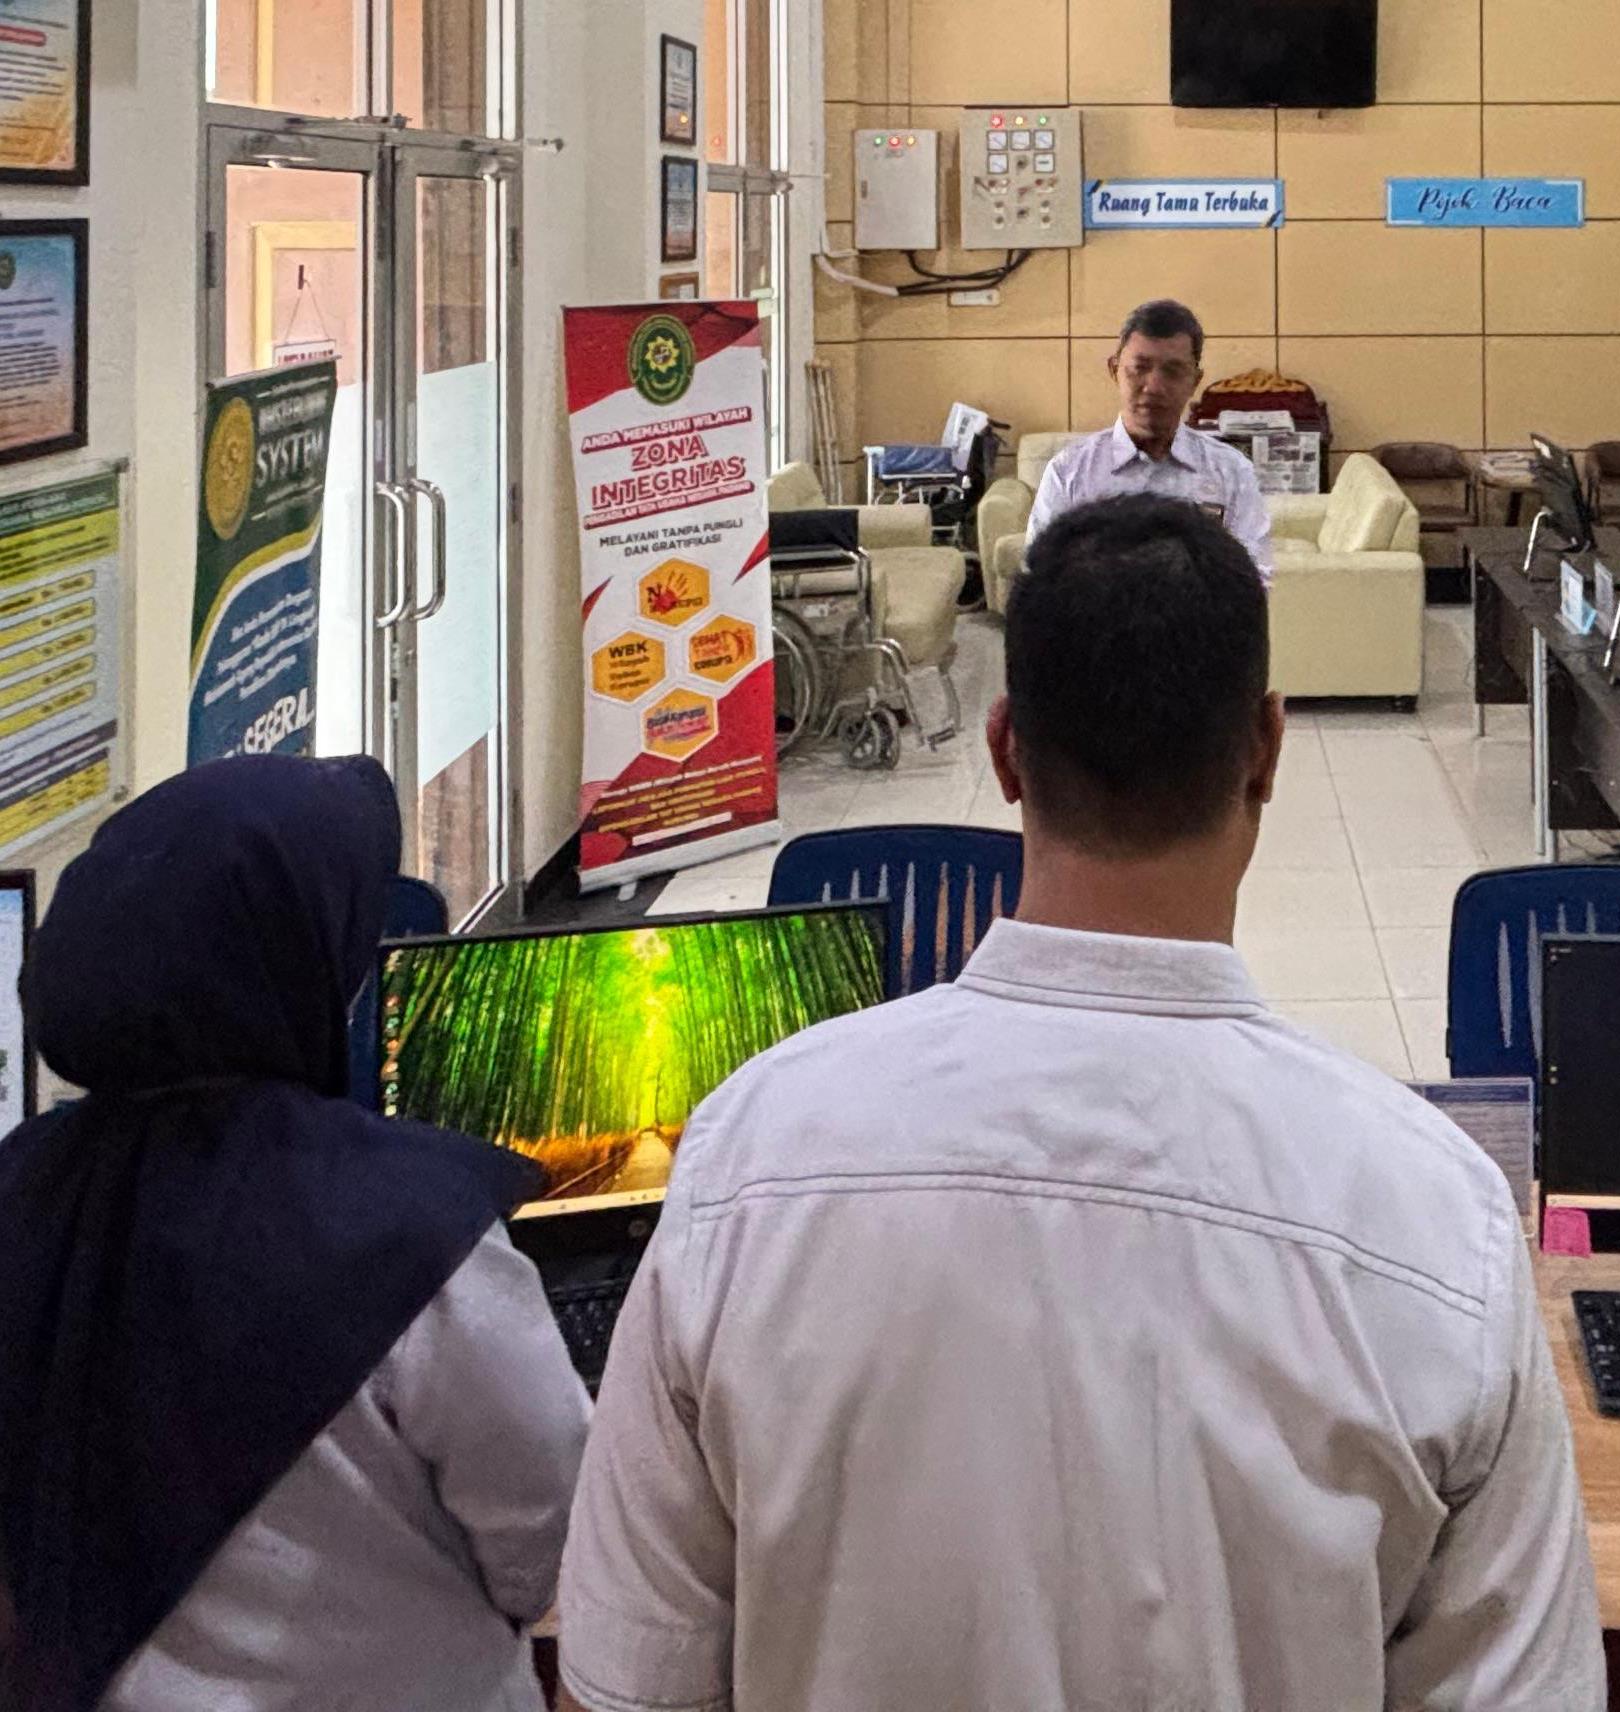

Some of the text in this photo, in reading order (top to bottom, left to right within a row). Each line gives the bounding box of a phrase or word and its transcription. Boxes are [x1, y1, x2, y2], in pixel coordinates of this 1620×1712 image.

[1098, 190, 1268, 216] Ruang Tamu Terbuka
[1418, 186, 1552, 221] Pojok Baca
[583, 407, 749, 450] ANDA MEMASUKI WILAYAH
[592, 456, 746, 509] INTEGRITAS
[599, 517, 743, 548] MELAYANI TANPA PUNGLI
[624, 534, 722, 557] DAN GRATIFIKASI
[609, 641, 648, 659] WBK
